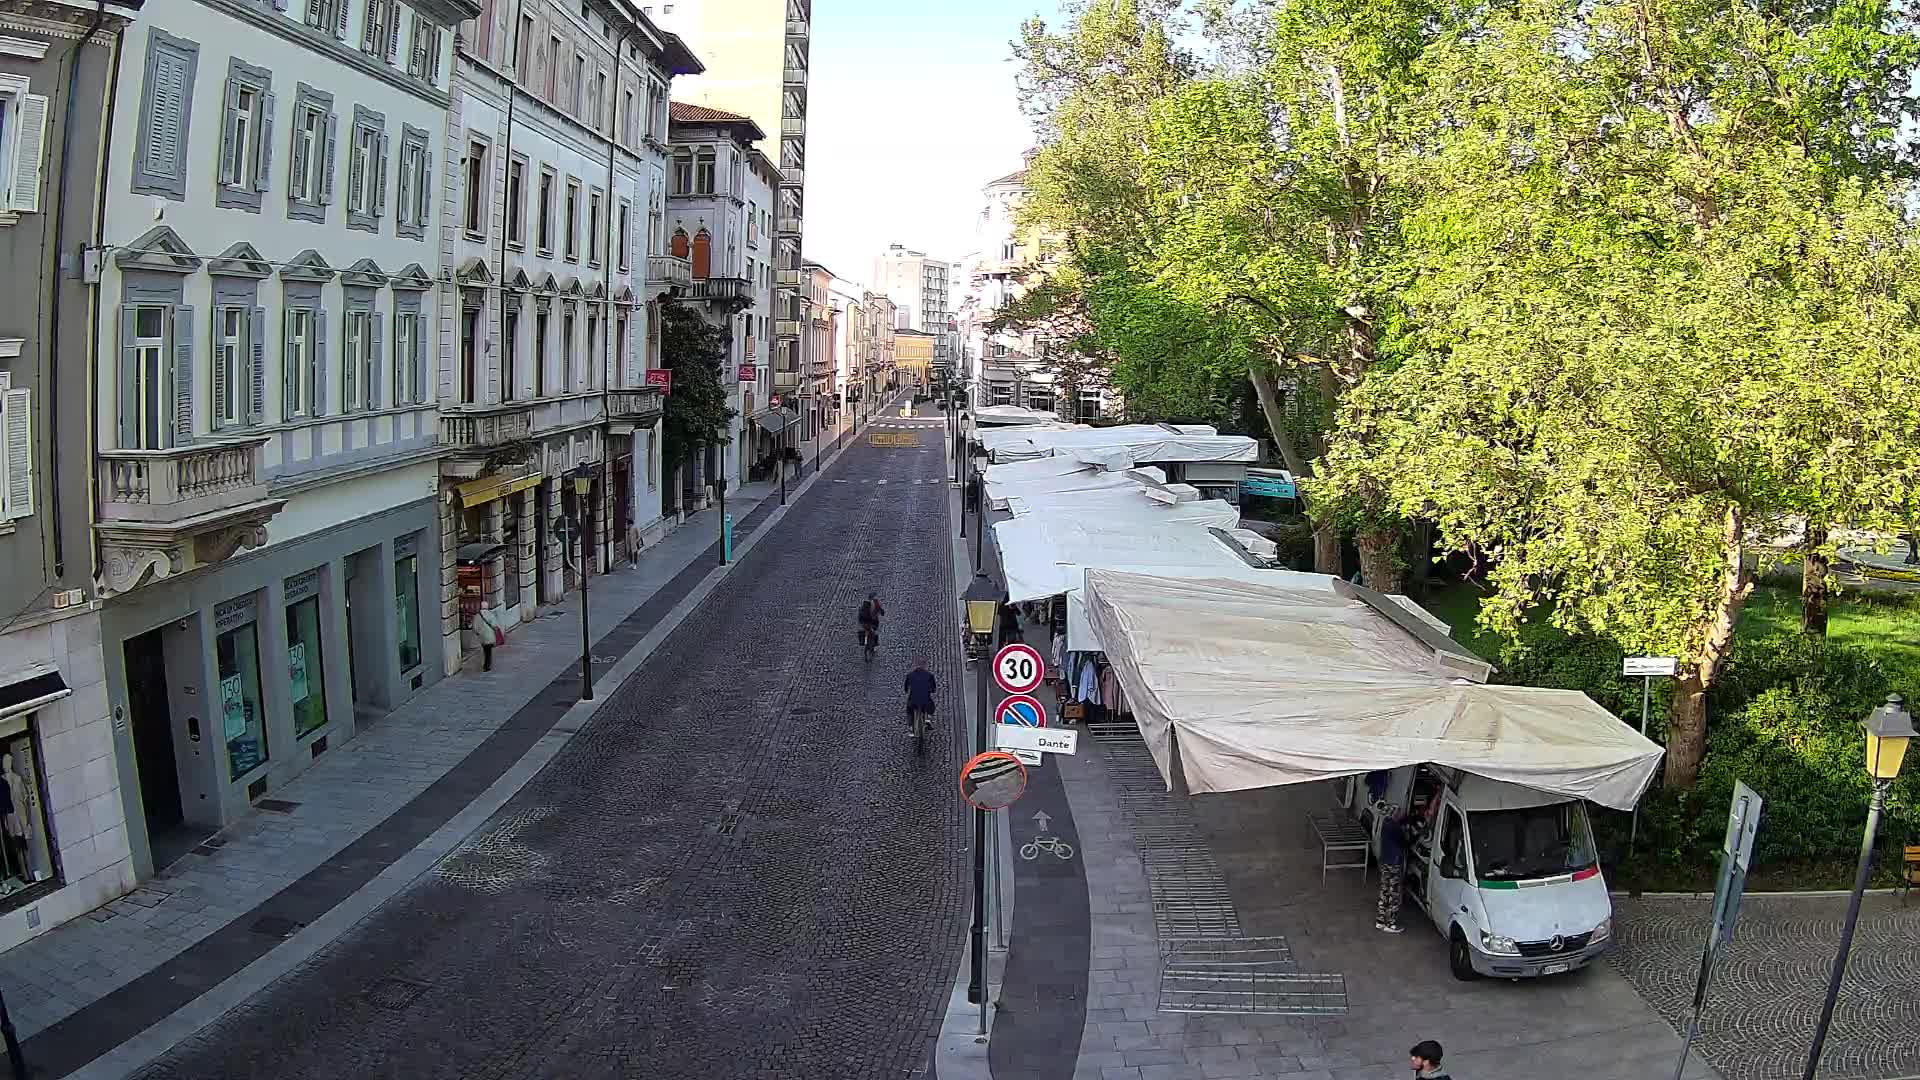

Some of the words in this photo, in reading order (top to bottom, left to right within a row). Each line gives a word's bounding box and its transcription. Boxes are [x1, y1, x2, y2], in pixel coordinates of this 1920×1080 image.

[1005, 658, 1033, 680] 30
[222, 677, 240, 700] 130
[1038, 738, 1070, 749] Dante
